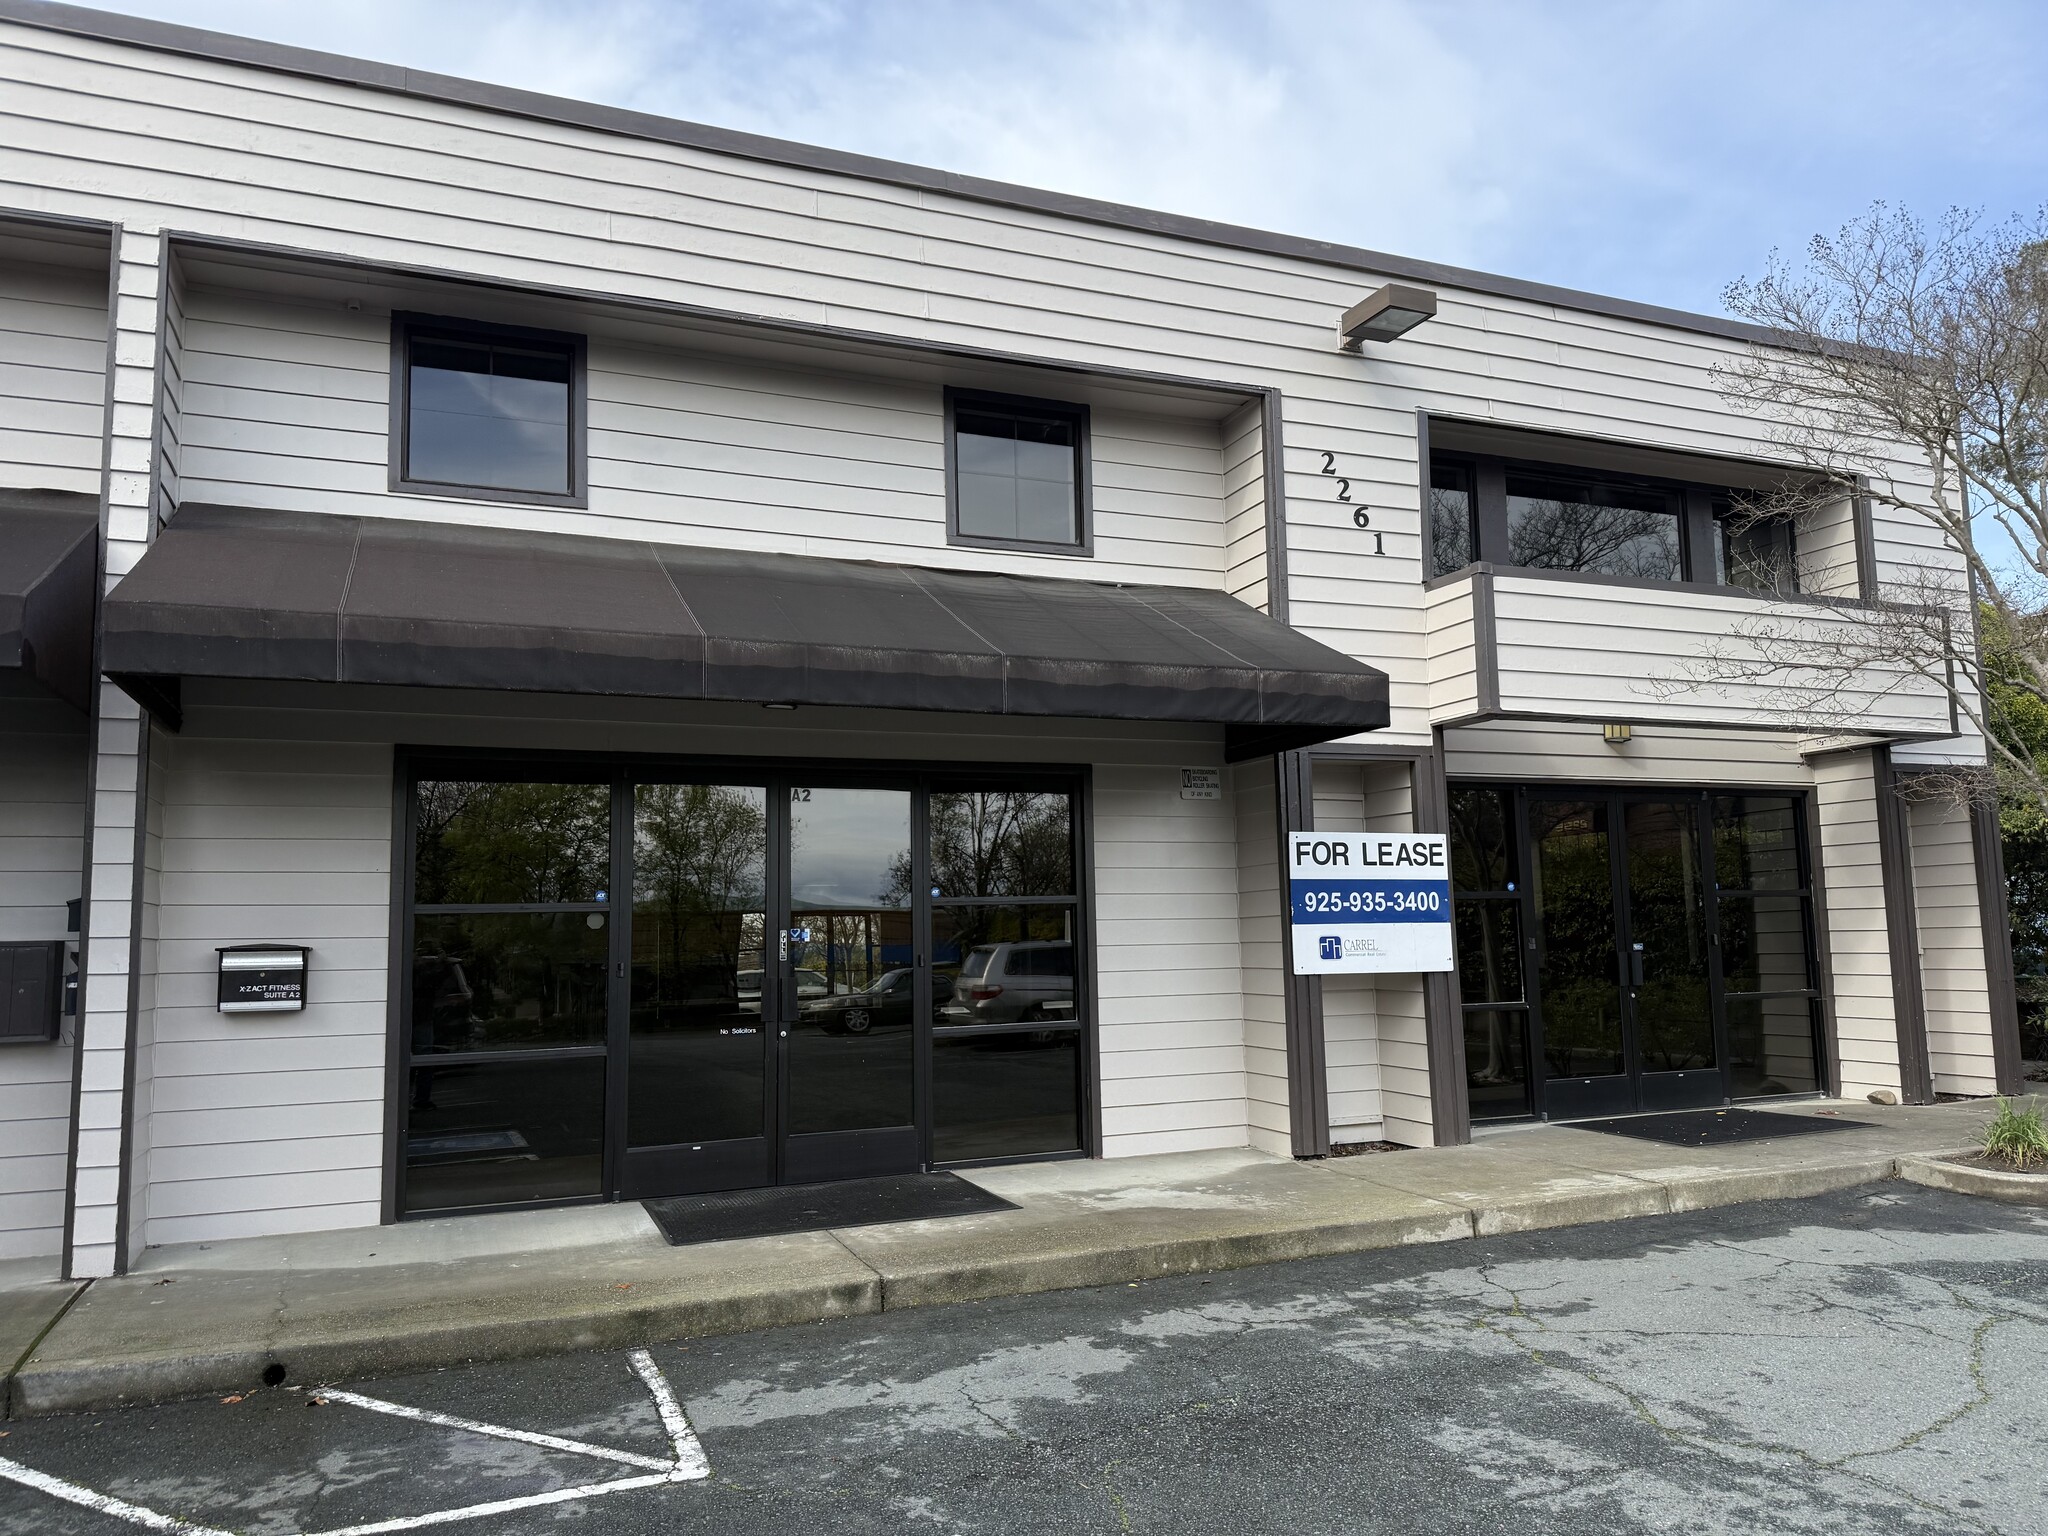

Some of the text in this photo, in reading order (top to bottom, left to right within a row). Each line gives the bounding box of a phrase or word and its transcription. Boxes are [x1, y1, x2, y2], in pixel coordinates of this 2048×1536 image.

[791, 788, 811, 802] A2
[1295, 841, 1445, 867] FOR LEASE
[1304, 891, 1440, 912] 925-935-3400
[1344, 939, 1379, 951] CARREL
